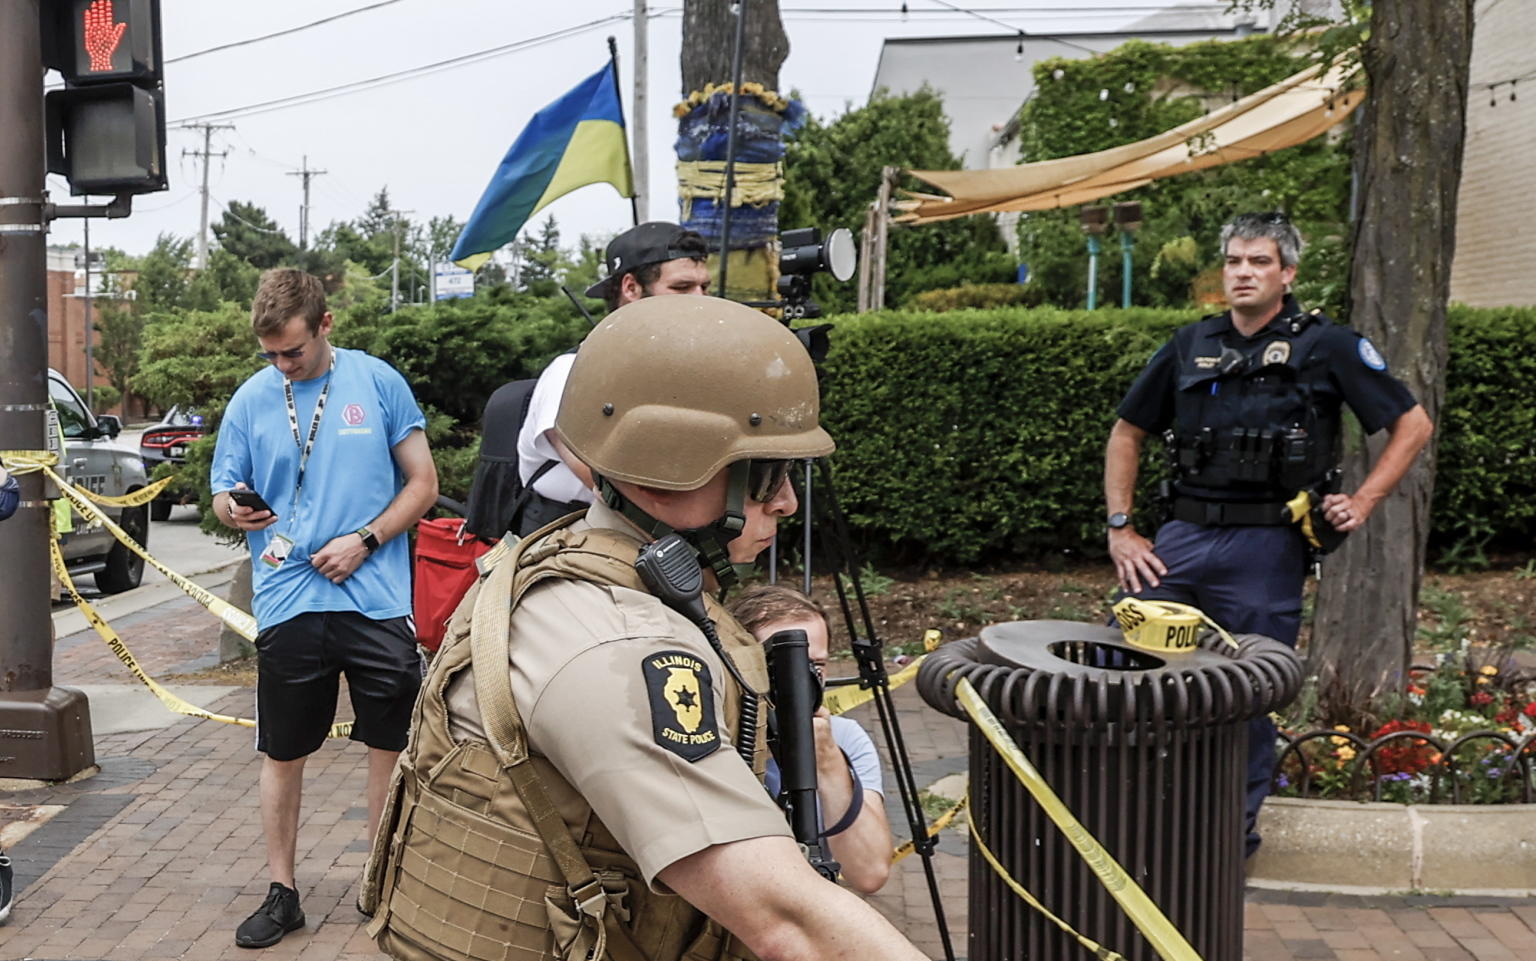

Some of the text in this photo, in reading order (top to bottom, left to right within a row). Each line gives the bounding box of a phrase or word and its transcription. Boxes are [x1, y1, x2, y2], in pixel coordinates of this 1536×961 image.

[1165, 624, 1200, 649] POLI
[107, 637, 136, 669] POLICE
[652, 655, 703, 672] ILLINOIS
[662, 727, 716, 745] STATE POLICE
